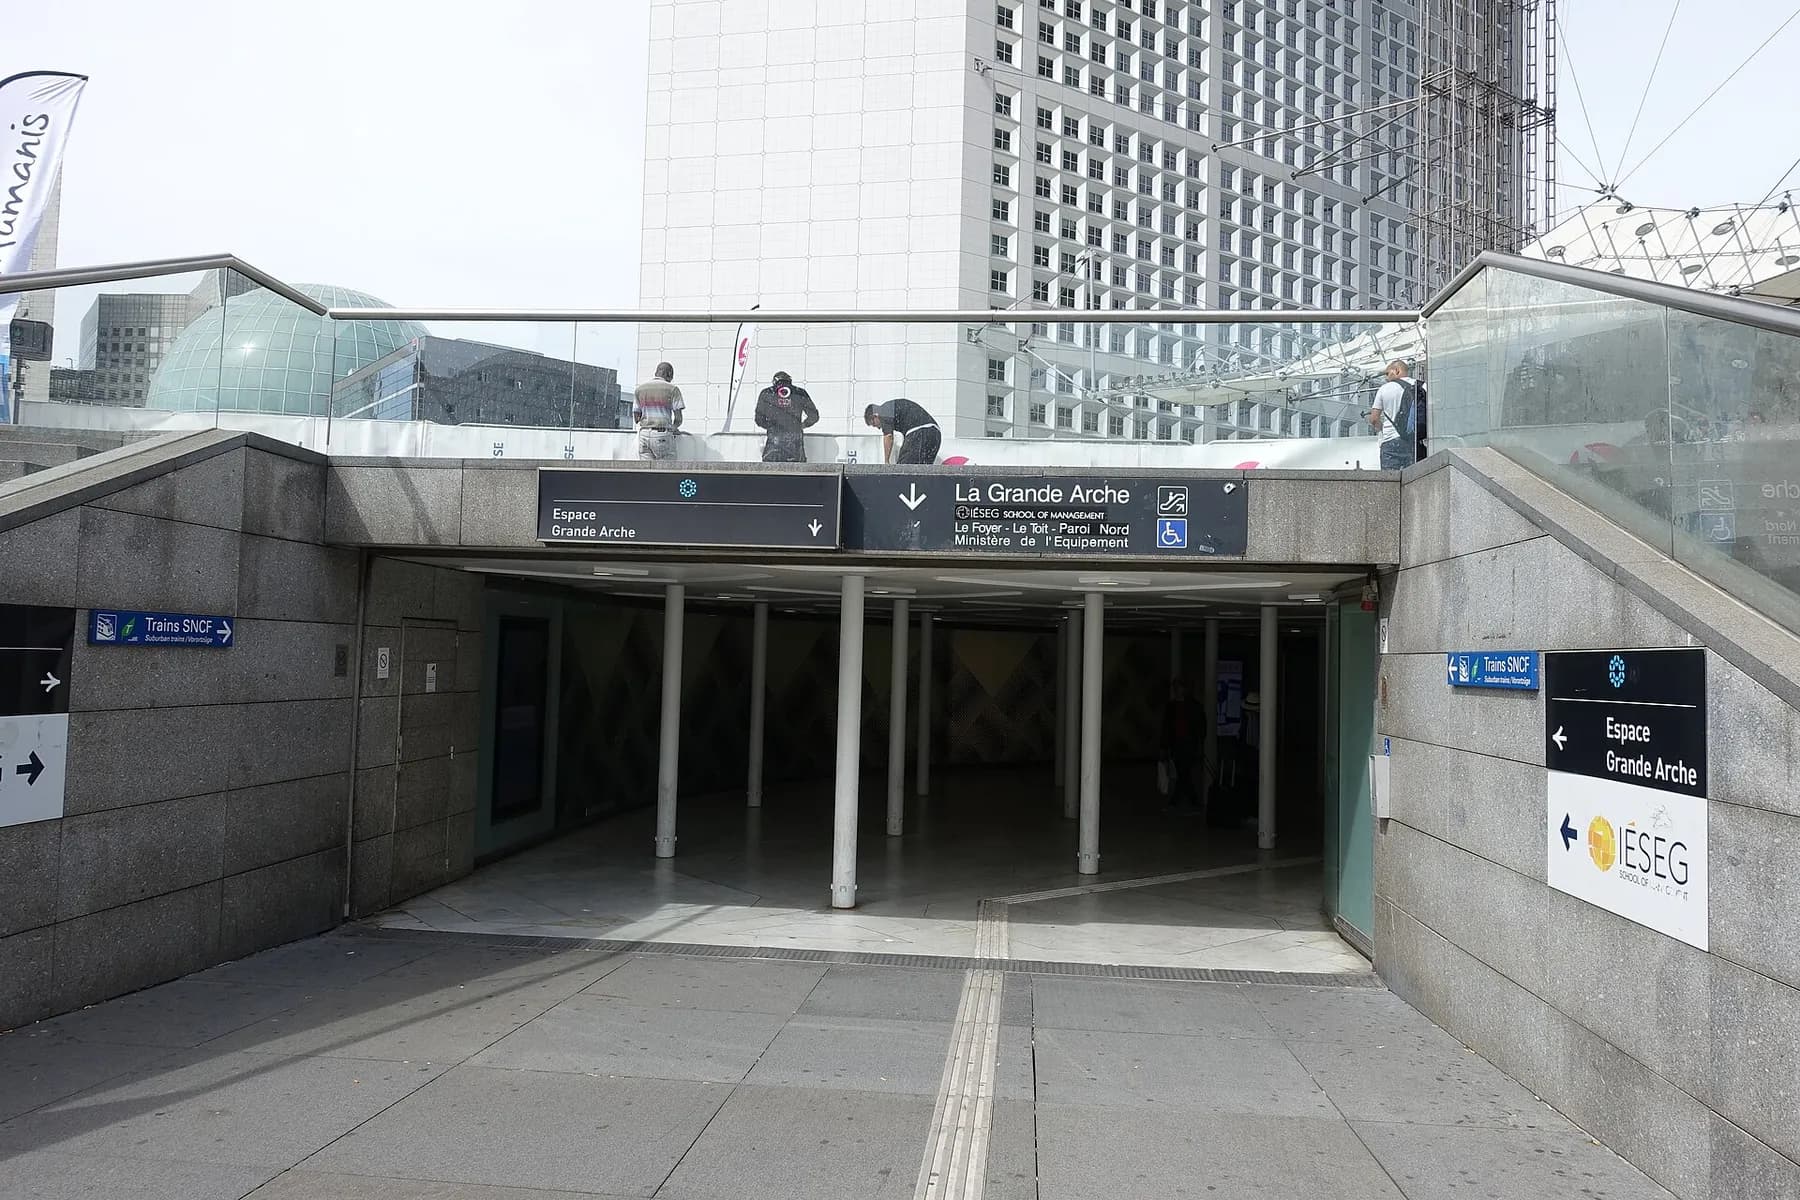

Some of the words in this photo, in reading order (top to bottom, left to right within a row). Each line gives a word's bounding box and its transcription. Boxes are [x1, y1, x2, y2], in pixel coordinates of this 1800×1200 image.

[0, 113, 50, 249] umanis
[493, 441, 504, 458] SE
[955, 483, 980, 502] La
[988, 483, 1063, 503] Grande
[1069, 484, 1130, 504] Arche
[553, 508, 597, 523] Espace
[970, 507, 1000, 519] IÉSEG
[1003, 510, 1036, 519] SCHOOL
[1038, 511, 1049, 519] OF
[1050, 511, 1105, 520] MANAGEMENT
[552, 524, 597, 537] Grande
[599, 525, 636, 538] Arche
[955, 522, 969, 533] Le
[972, 523, 1001, 536] Foyer
[1013, 523, 1027, 534] Le
[1030, 523, 1049, 534] Toit
[1059, 523, 1091, 535] Paroi
[1100, 524, 1130, 536] Nord
[955, 535, 1011, 547] Ministère
[1020, 536, 1036, 547] de
[145, 616, 180, 633] Trains
[182, 618, 213, 634] SNCF
[1484, 656, 1506, 672] Trains
[1507, 655, 1530, 673] SNCF
[1606, 716, 1651, 746] Espace
[1606, 749, 1652, 778] Grande
[1654, 756, 1698, 786] Arche
[1619, 820, 1688, 886] IÉSEG
[1619, 869, 1641, 885] SCHOOL
